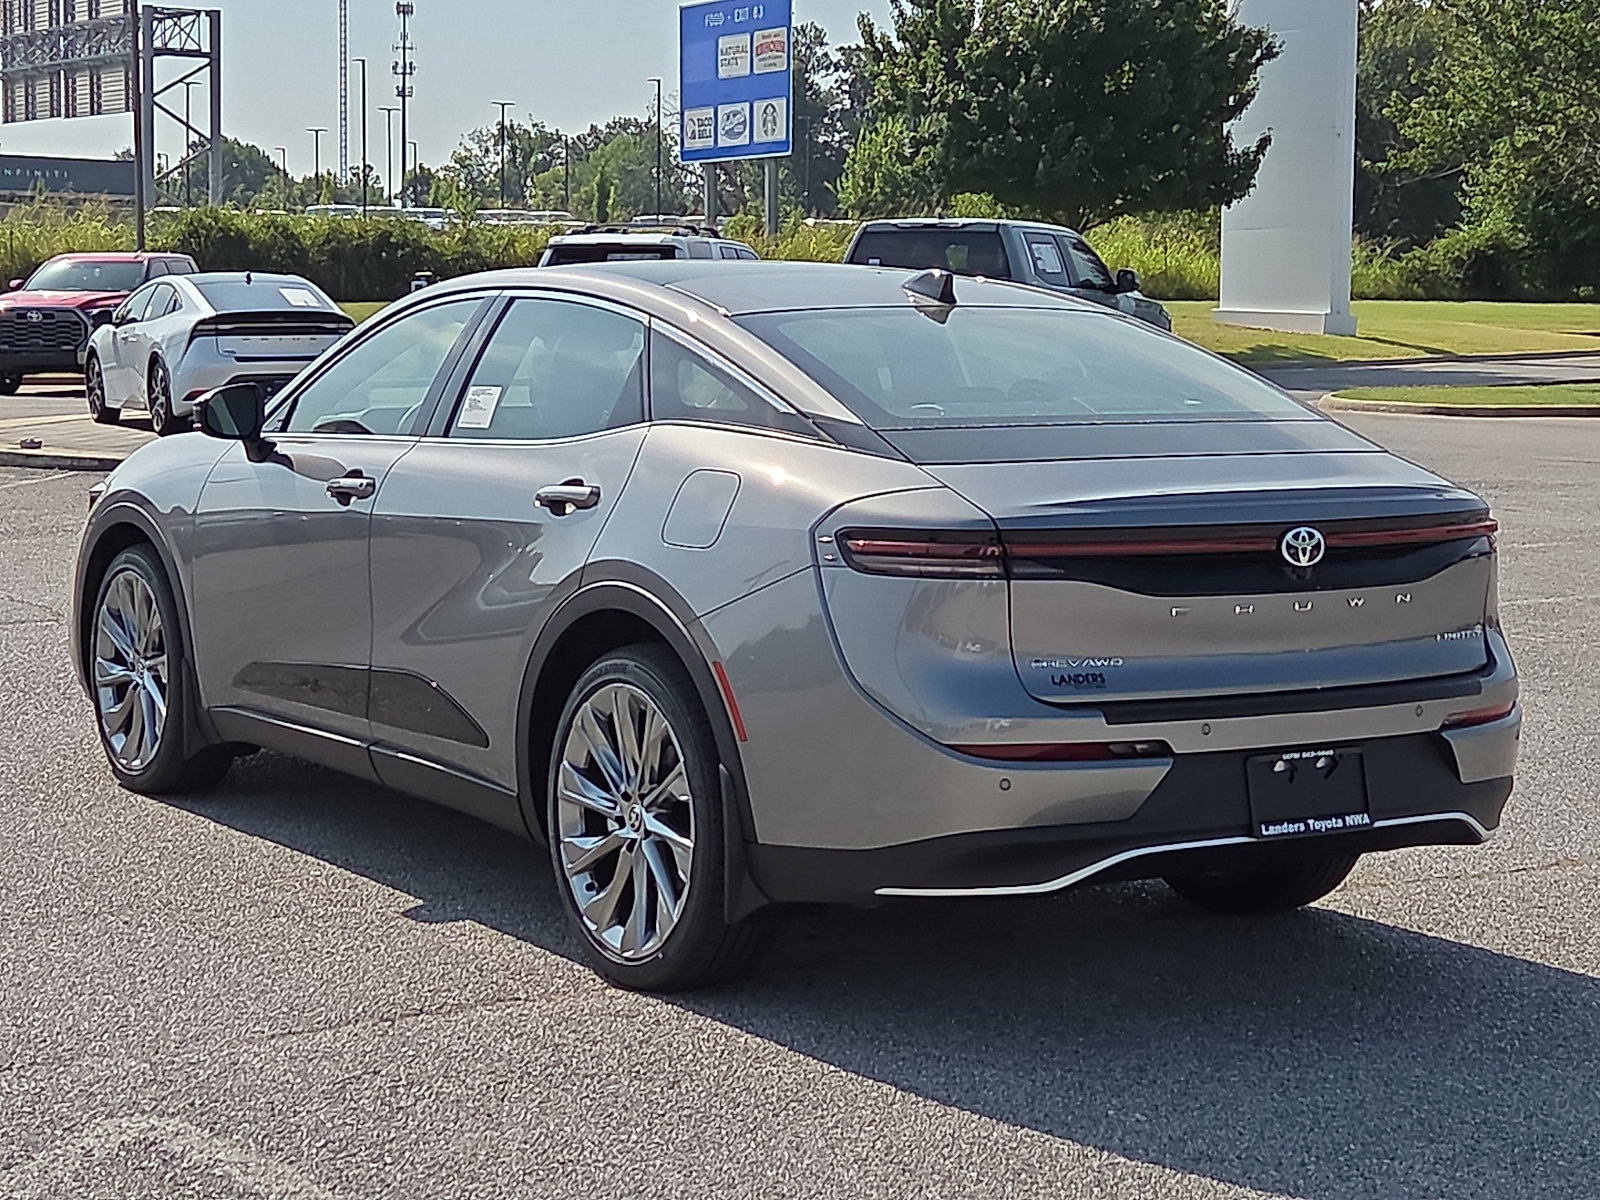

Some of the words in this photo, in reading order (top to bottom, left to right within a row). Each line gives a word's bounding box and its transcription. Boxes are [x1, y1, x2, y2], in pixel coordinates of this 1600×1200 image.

[697, 116, 713, 128] TACO
[697, 129, 712, 140] BELL
[1050, 672, 1107, 687] LANDERS
[1260, 820, 1306, 836] Landers
[1307, 816, 1344, 833] Toyota
[1344, 812, 1371, 827] NWA
